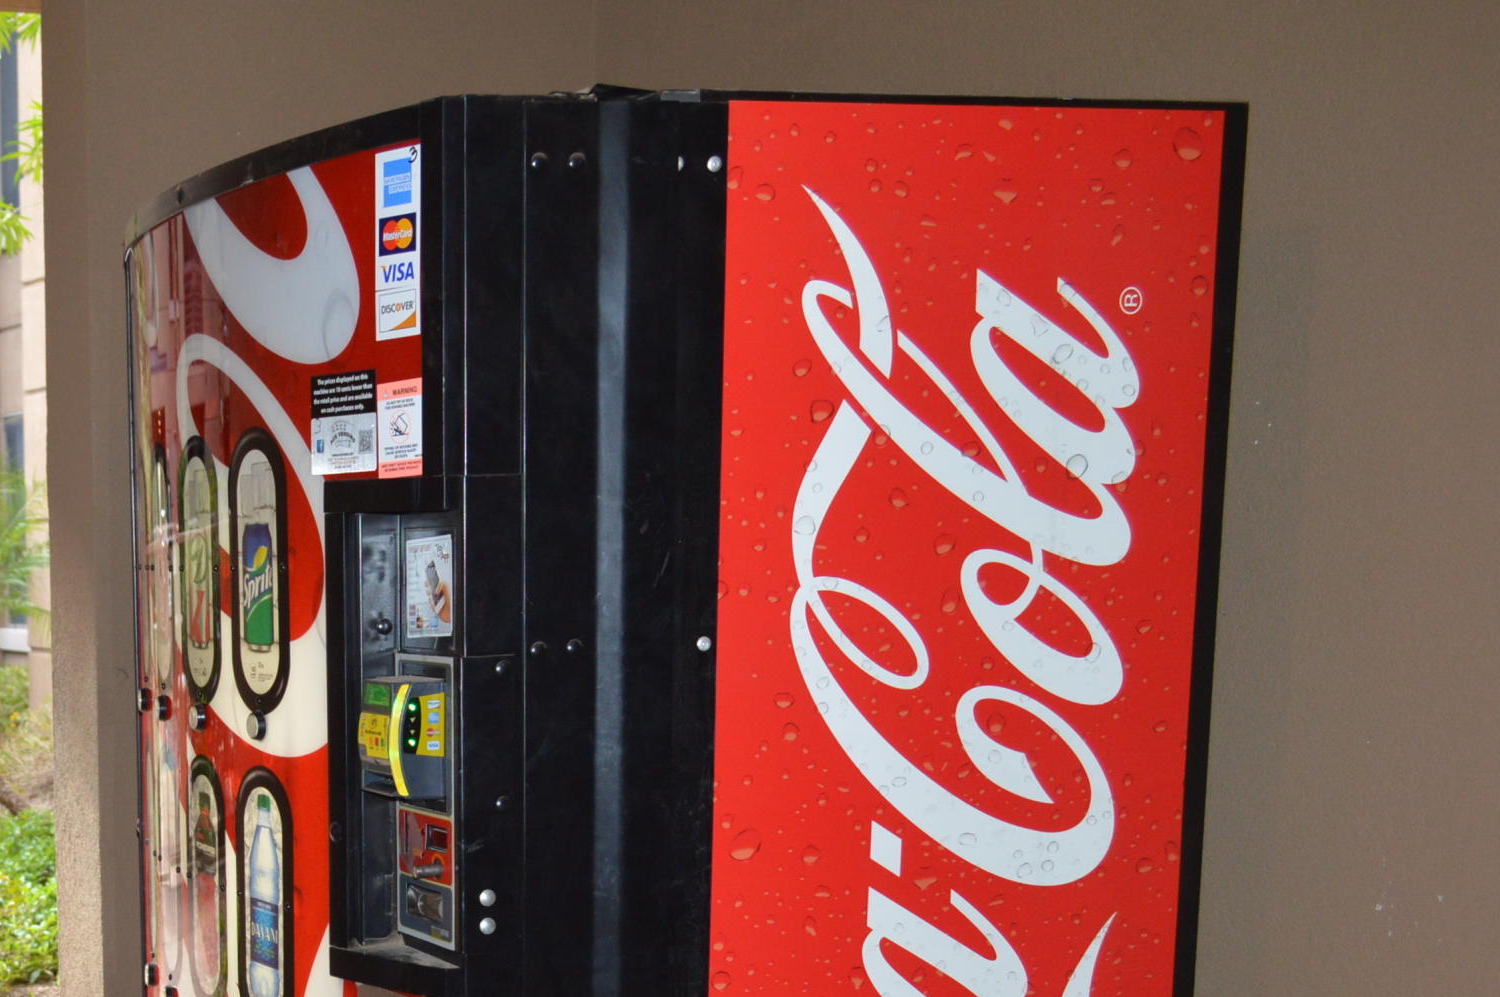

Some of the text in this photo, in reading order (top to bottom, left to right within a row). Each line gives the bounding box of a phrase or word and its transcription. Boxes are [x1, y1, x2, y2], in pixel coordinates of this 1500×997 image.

[382, 229, 413, 242] MasterCard
[380, 261, 415, 283] VISA
[381, 301, 414, 315] DISCOVER
[336, 375, 354, 384] displayed
[355, 392, 372, 401] available
[392, 386, 417, 396] WARNING
[244, 564, 273, 608] Sprite
